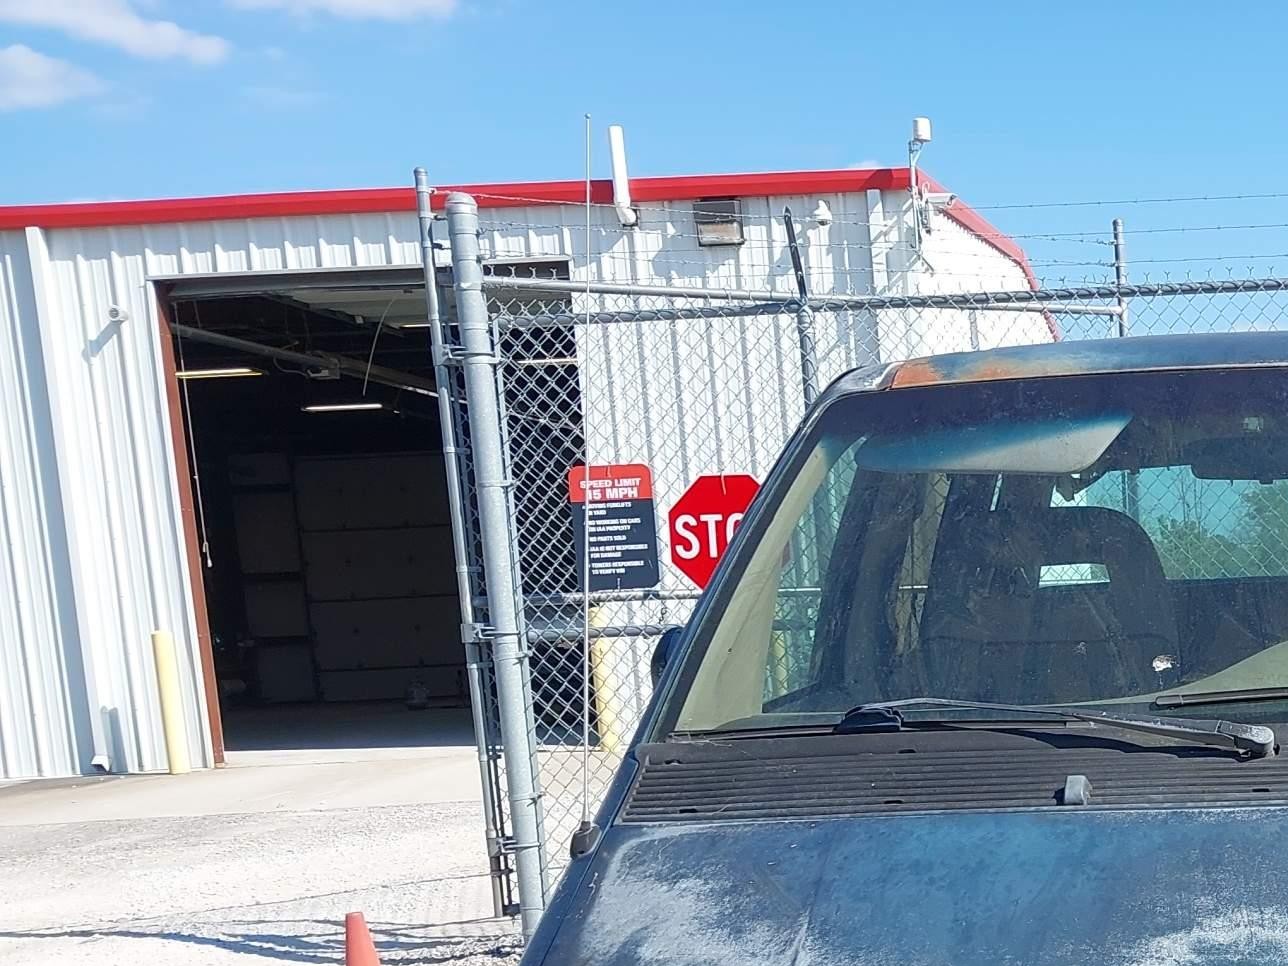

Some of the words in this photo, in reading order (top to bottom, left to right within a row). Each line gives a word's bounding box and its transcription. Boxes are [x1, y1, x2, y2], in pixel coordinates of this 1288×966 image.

[580, 479, 613, 489] SPEED
[615, 477, 641, 487] LIMIT
[605, 487, 639, 499] MPH
[675, 513, 744, 559] ST
